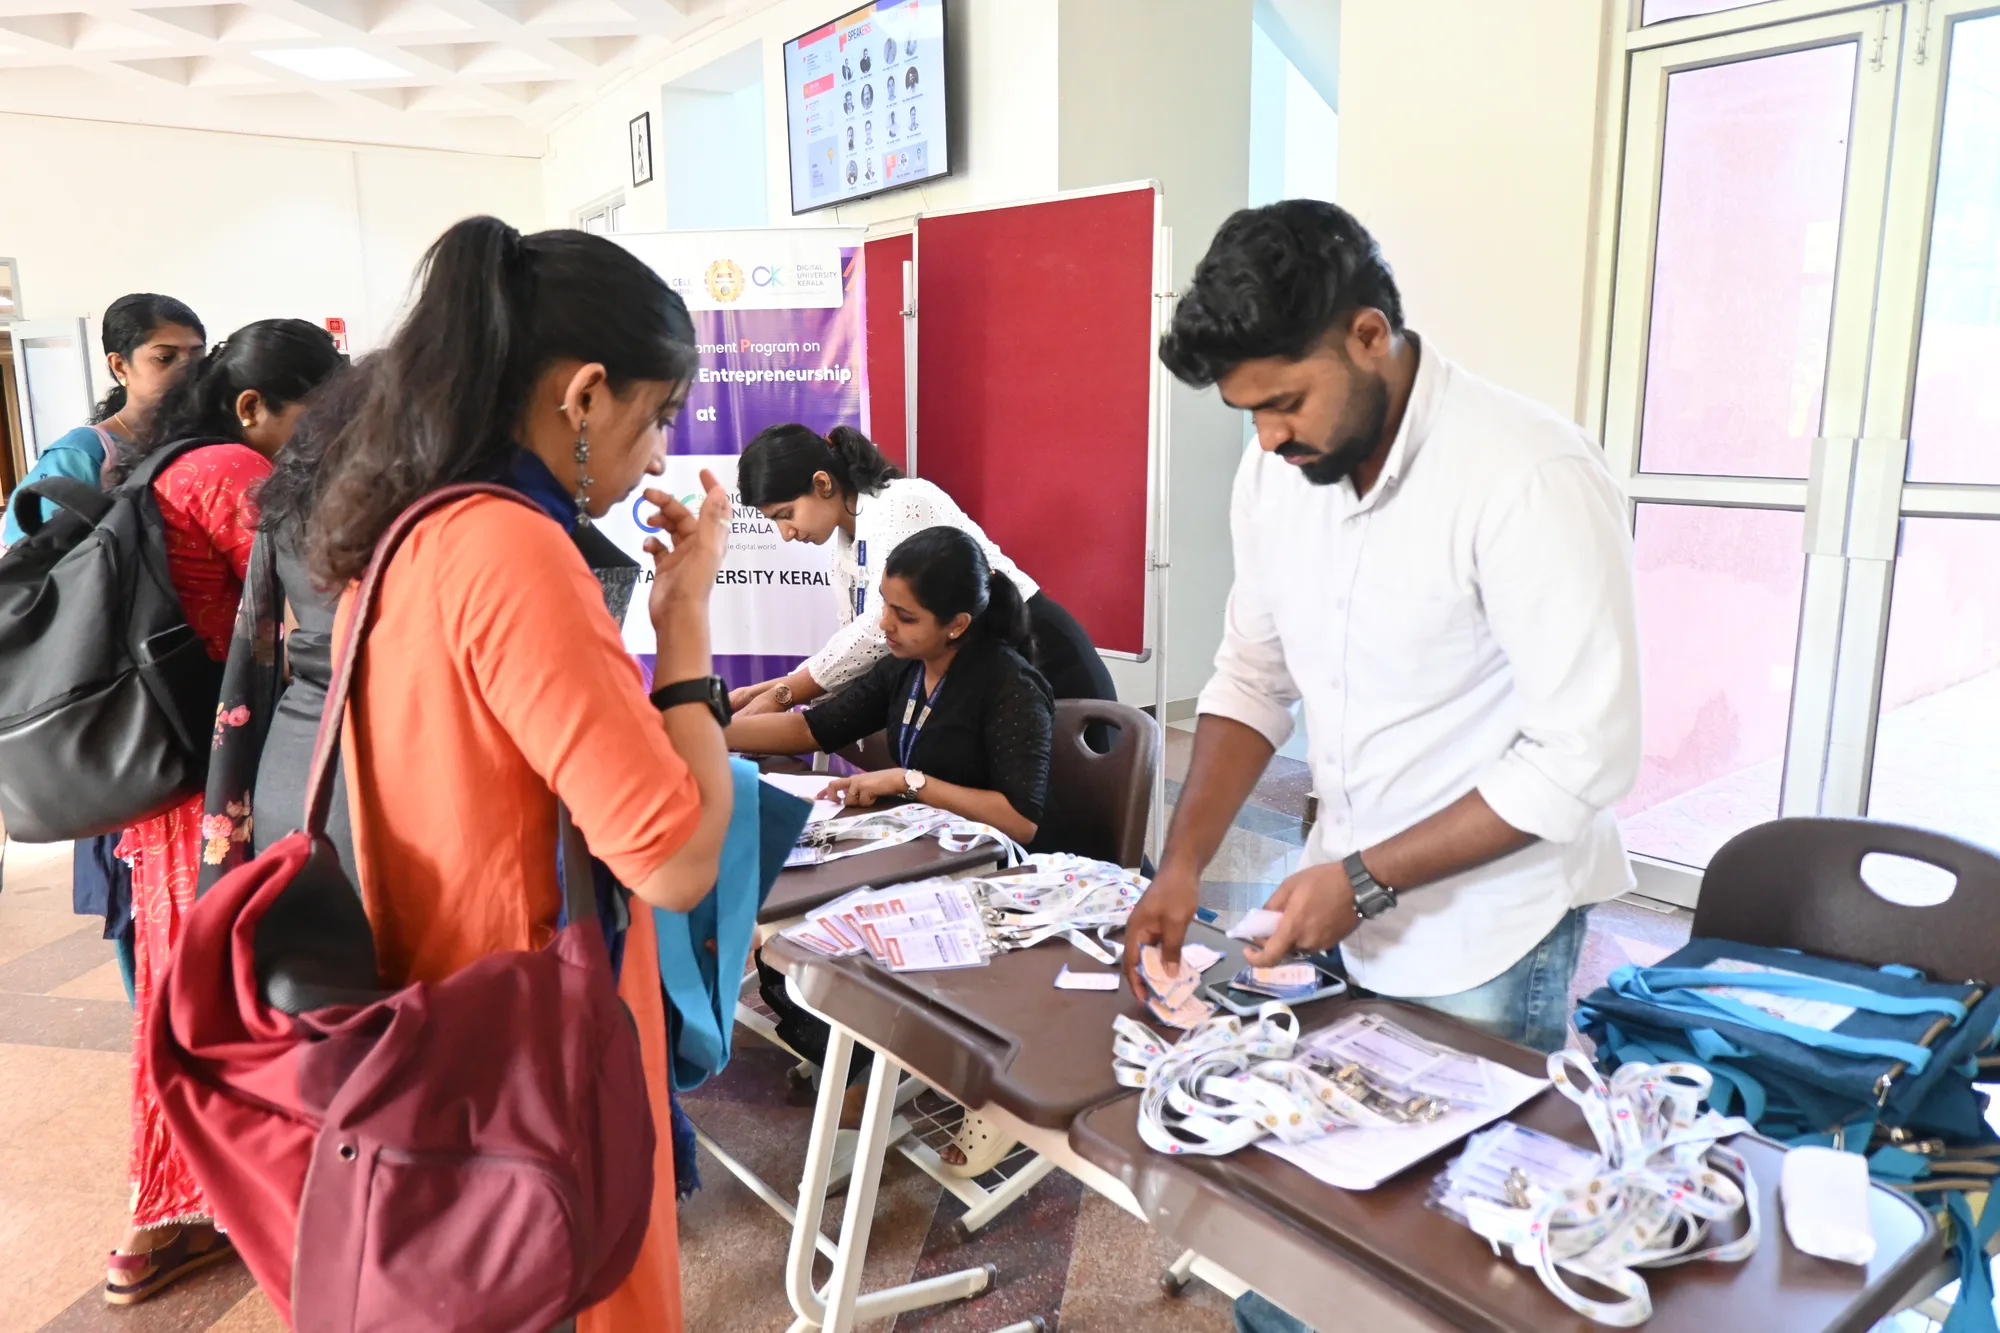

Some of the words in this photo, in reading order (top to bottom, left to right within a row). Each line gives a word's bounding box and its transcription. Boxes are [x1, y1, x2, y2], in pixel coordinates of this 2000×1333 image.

[796, 271, 837, 279] UNIVERSITY
[672, 278, 692, 287] CELL
[740, 338, 800, 356] Program
[803, 341, 820, 352] on
[699, 364, 852, 385] Entrepreneurship
[696, 406, 717, 421] at
[728, 522, 774, 534] ERALA
[735, 543, 756, 552] digital
[779, 570, 831, 586] KERAL
